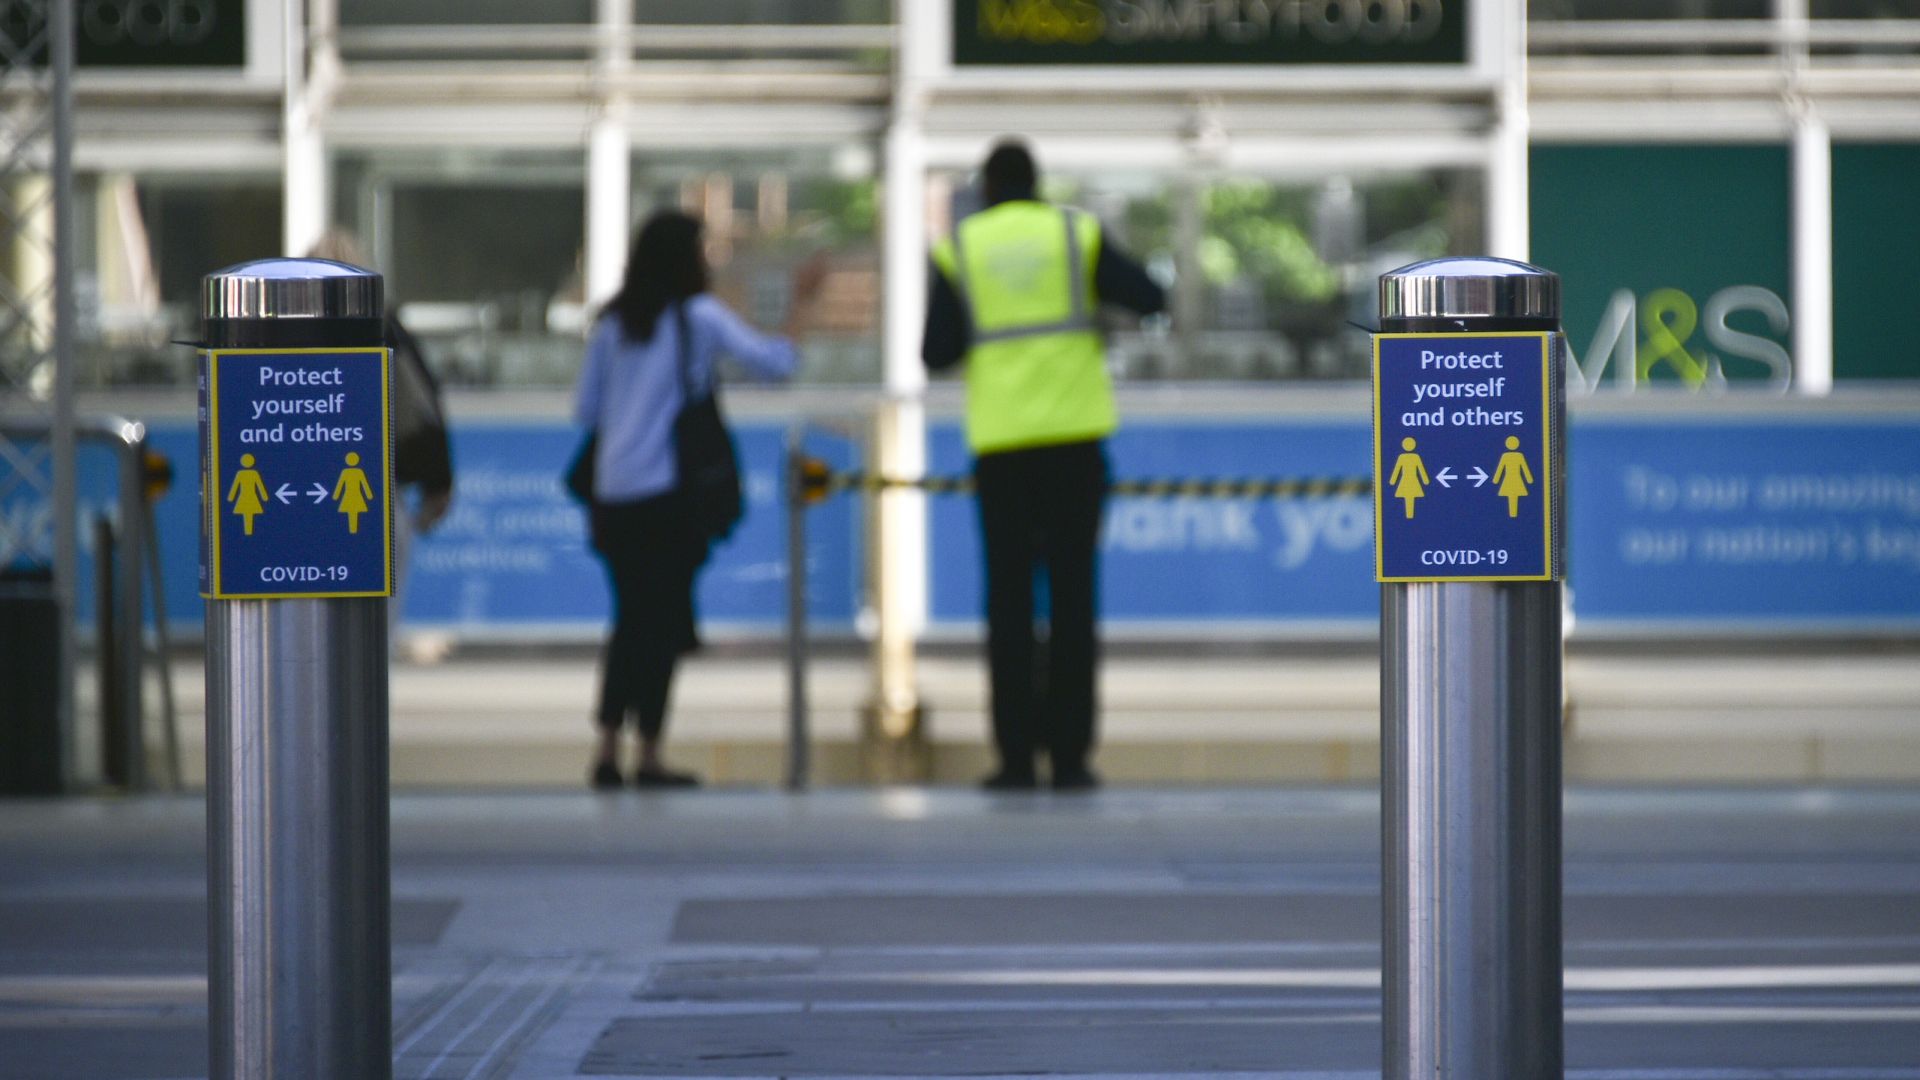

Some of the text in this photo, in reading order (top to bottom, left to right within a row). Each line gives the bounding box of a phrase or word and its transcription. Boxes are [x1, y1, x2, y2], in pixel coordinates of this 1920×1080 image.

[1563, 284, 1792, 397] M&S
[1421, 350, 1503, 370] Protect
[259, 367, 343, 386] Protect
[1413, 377, 1506, 403] yourself
[251, 393, 346, 420] yourself
[1402, 406, 1524, 427] and others
[240, 422, 364, 443] and others
[1270, 491, 1373, 570] yo
[1421, 549, 1508, 566] COVID-19
[259, 566, 349, 583] COVID-19
